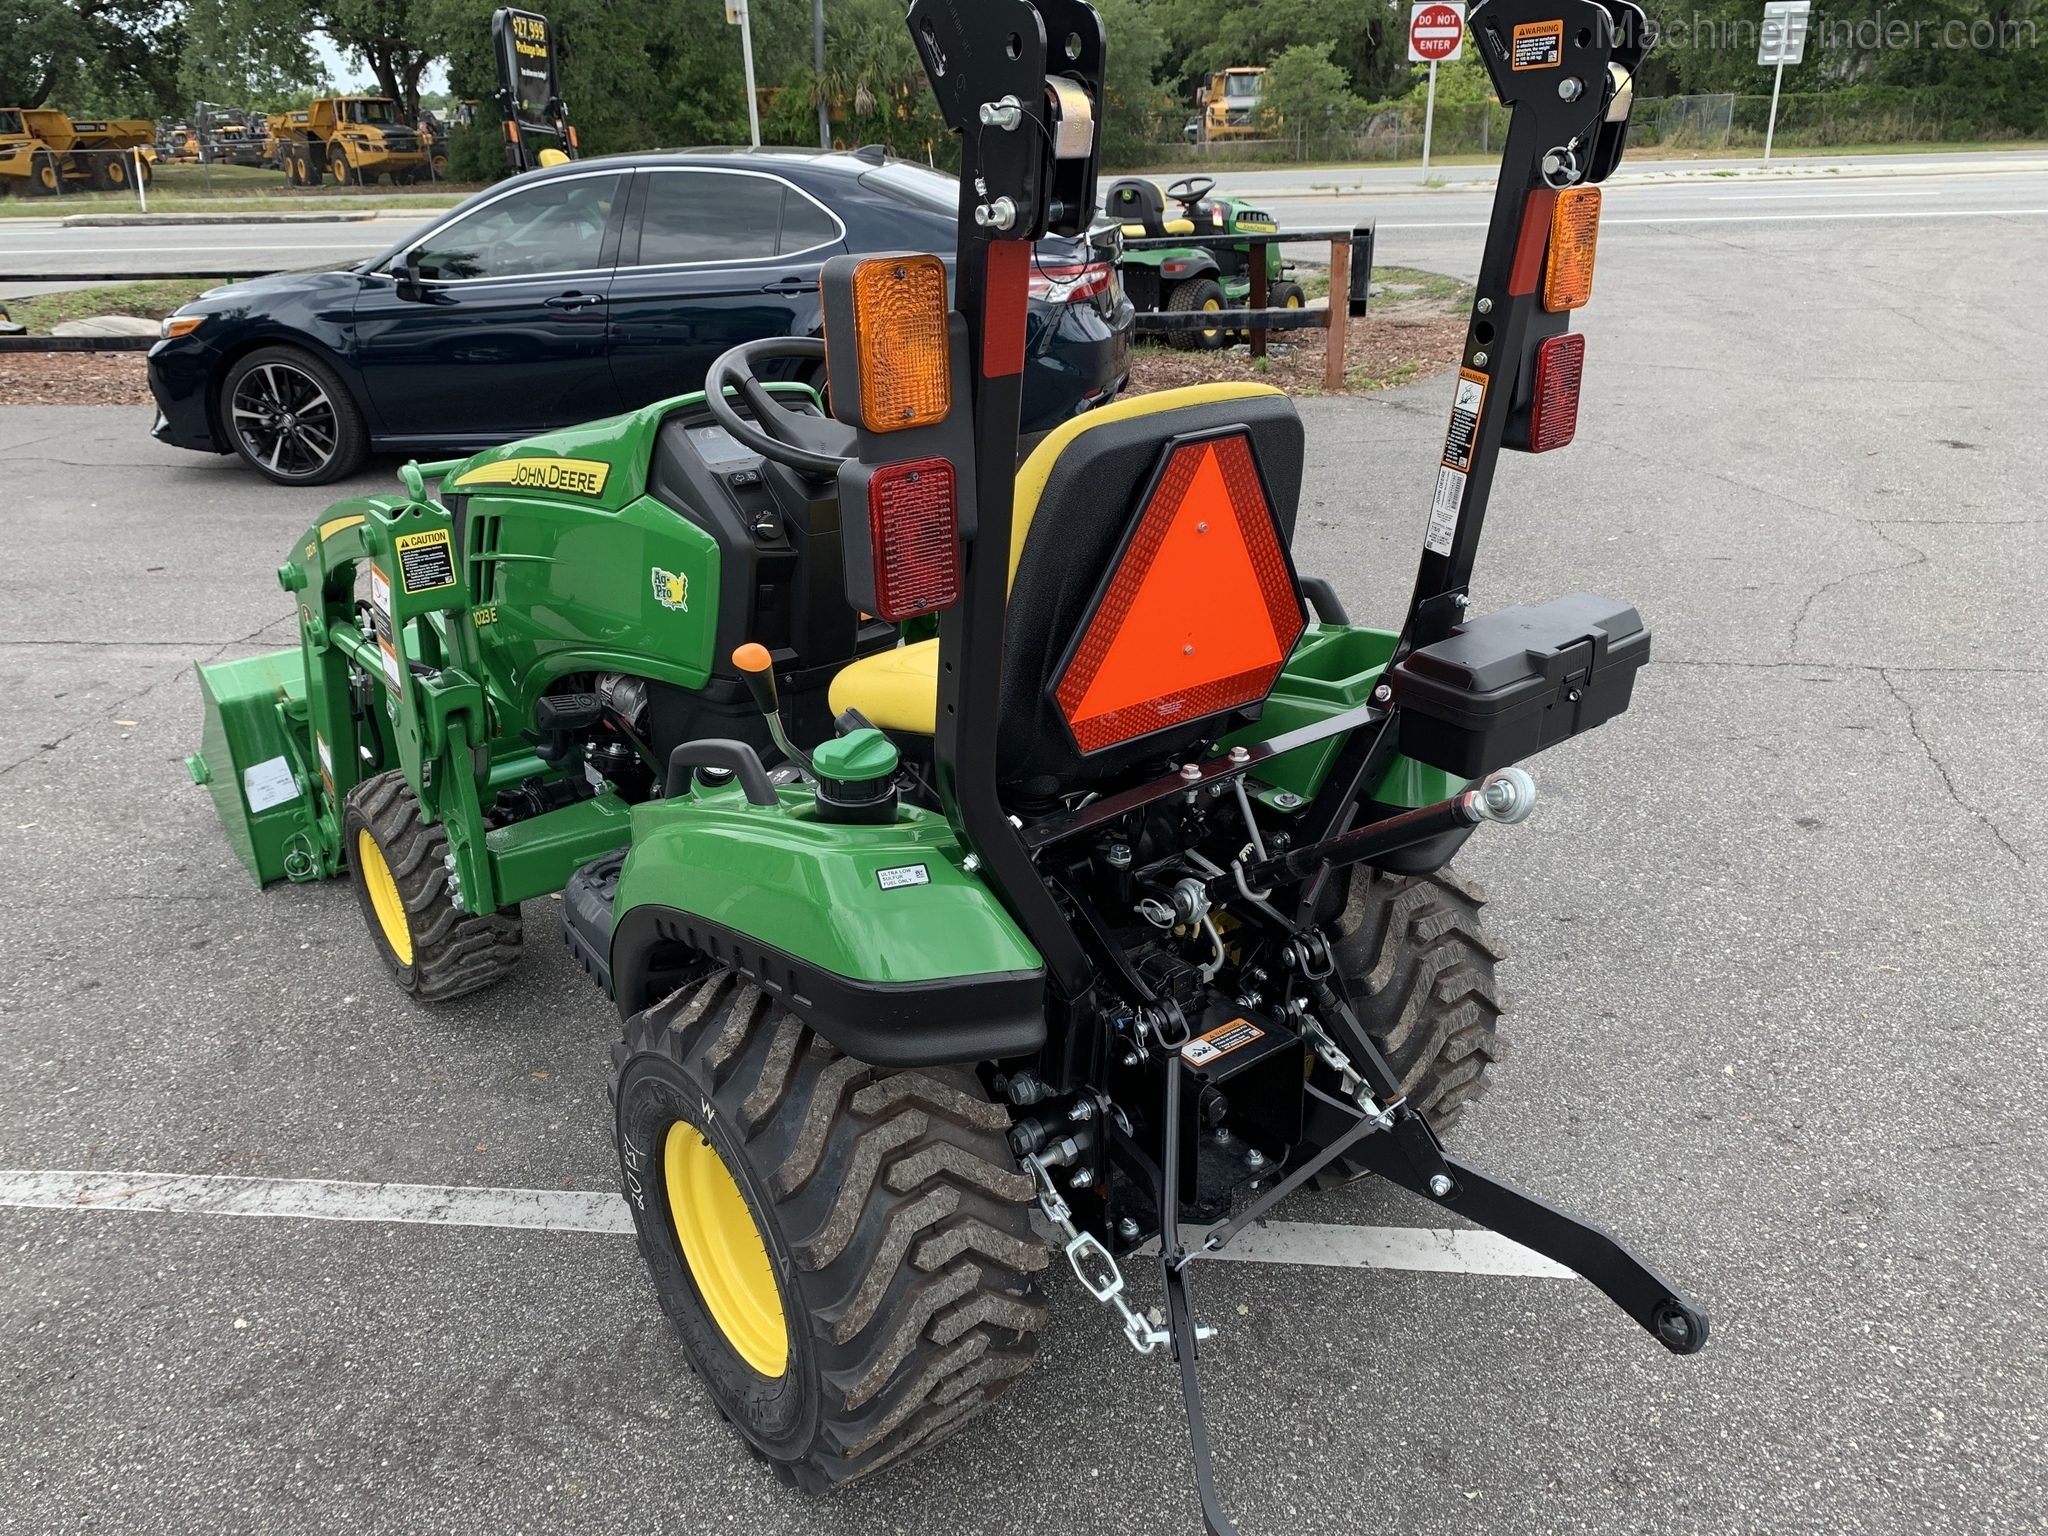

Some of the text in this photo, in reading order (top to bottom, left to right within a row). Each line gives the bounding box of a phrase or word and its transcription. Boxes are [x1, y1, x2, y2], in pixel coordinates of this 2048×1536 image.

[1419, 14, 1456, 25] DO NOT
[512, 17, 545, 41] $27,999
[1525, 24, 1559, 35] WARNING
[1420, 40, 1451, 50] ENTER
[511, 462, 598, 491] JOHN DEERE
[410, 531, 446, 546] CAUTION
[655, 571, 670, 587] Ag-
[656, 585, 672, 598] Pro
